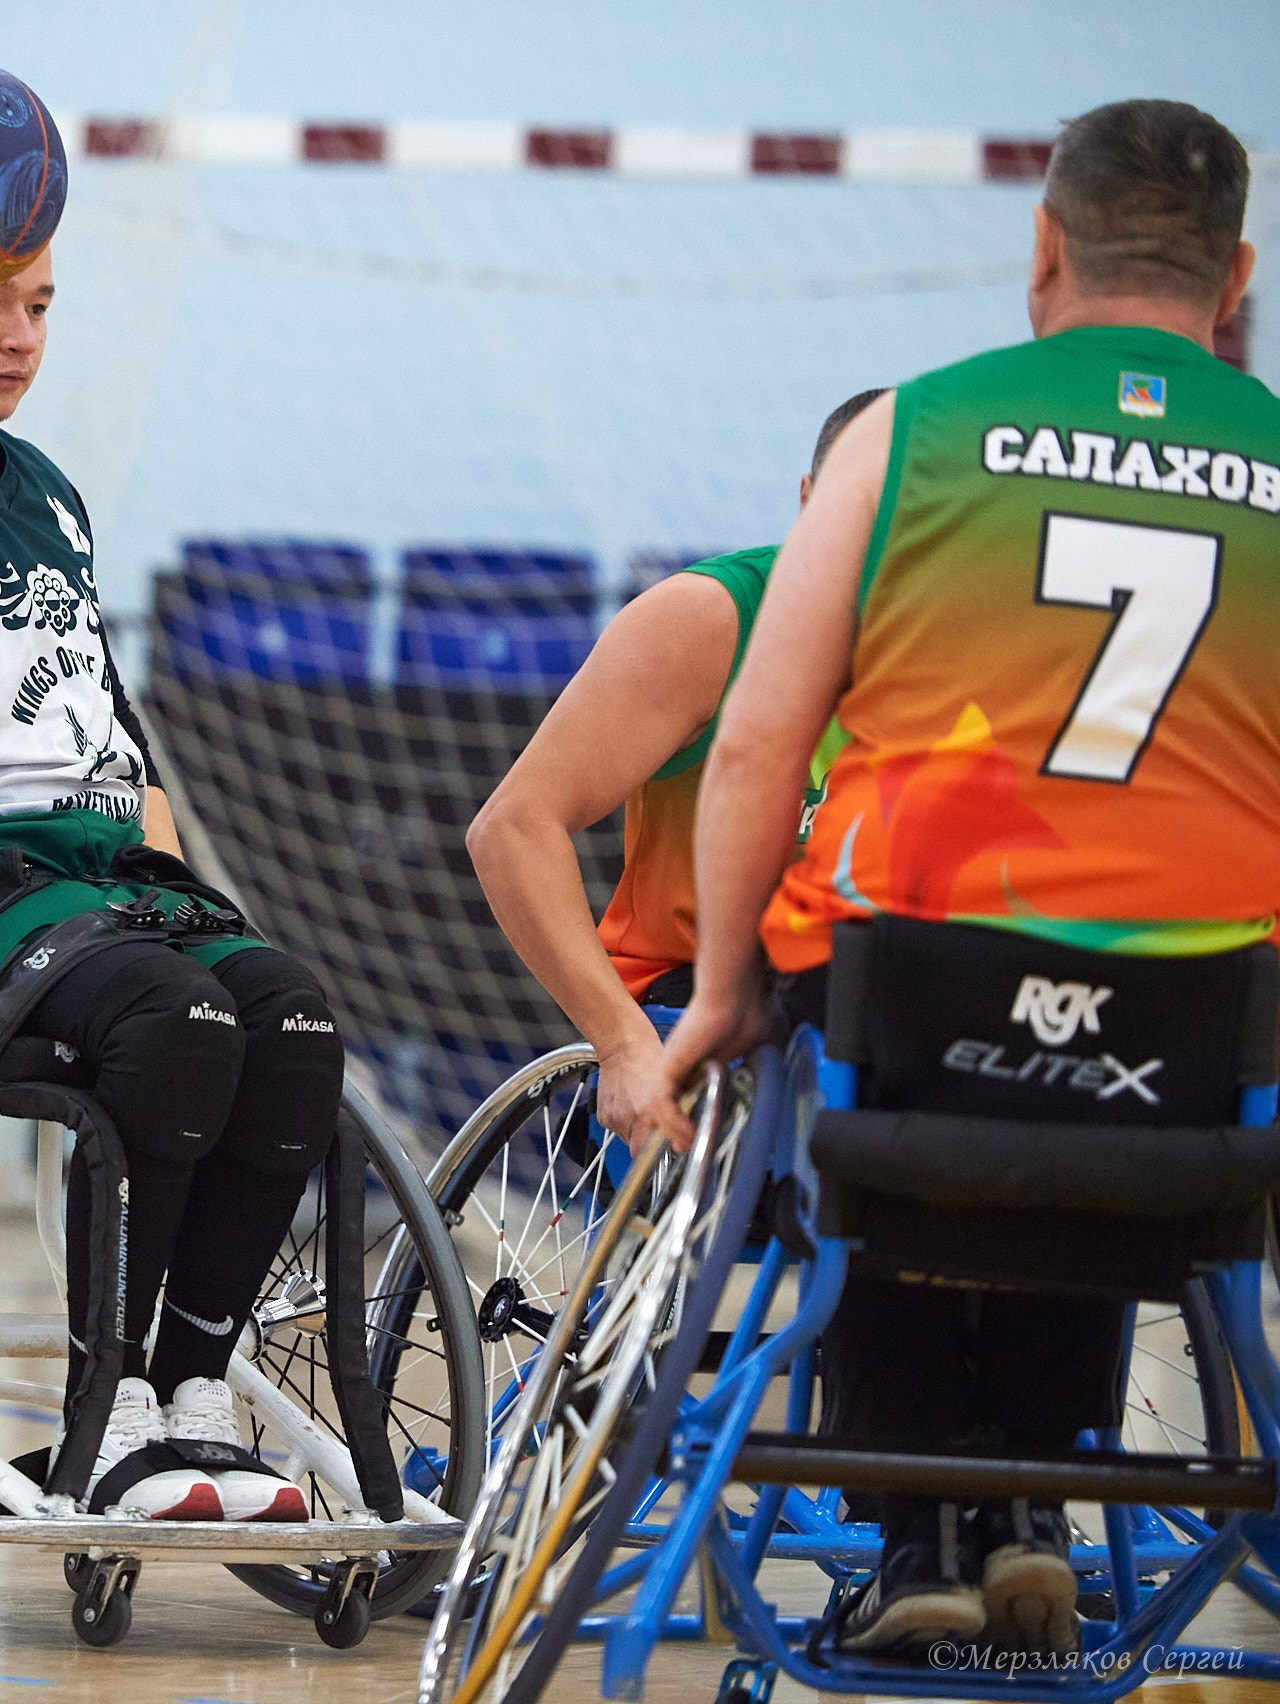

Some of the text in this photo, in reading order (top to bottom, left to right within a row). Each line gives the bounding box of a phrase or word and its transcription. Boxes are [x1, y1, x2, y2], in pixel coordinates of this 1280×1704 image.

[984, 426, 1280, 513] САЛАХОВ
[1034, 509, 1224, 786] 7
[11, 656, 58, 726] WINGS
[1011, 974, 1114, 1046] RGK
